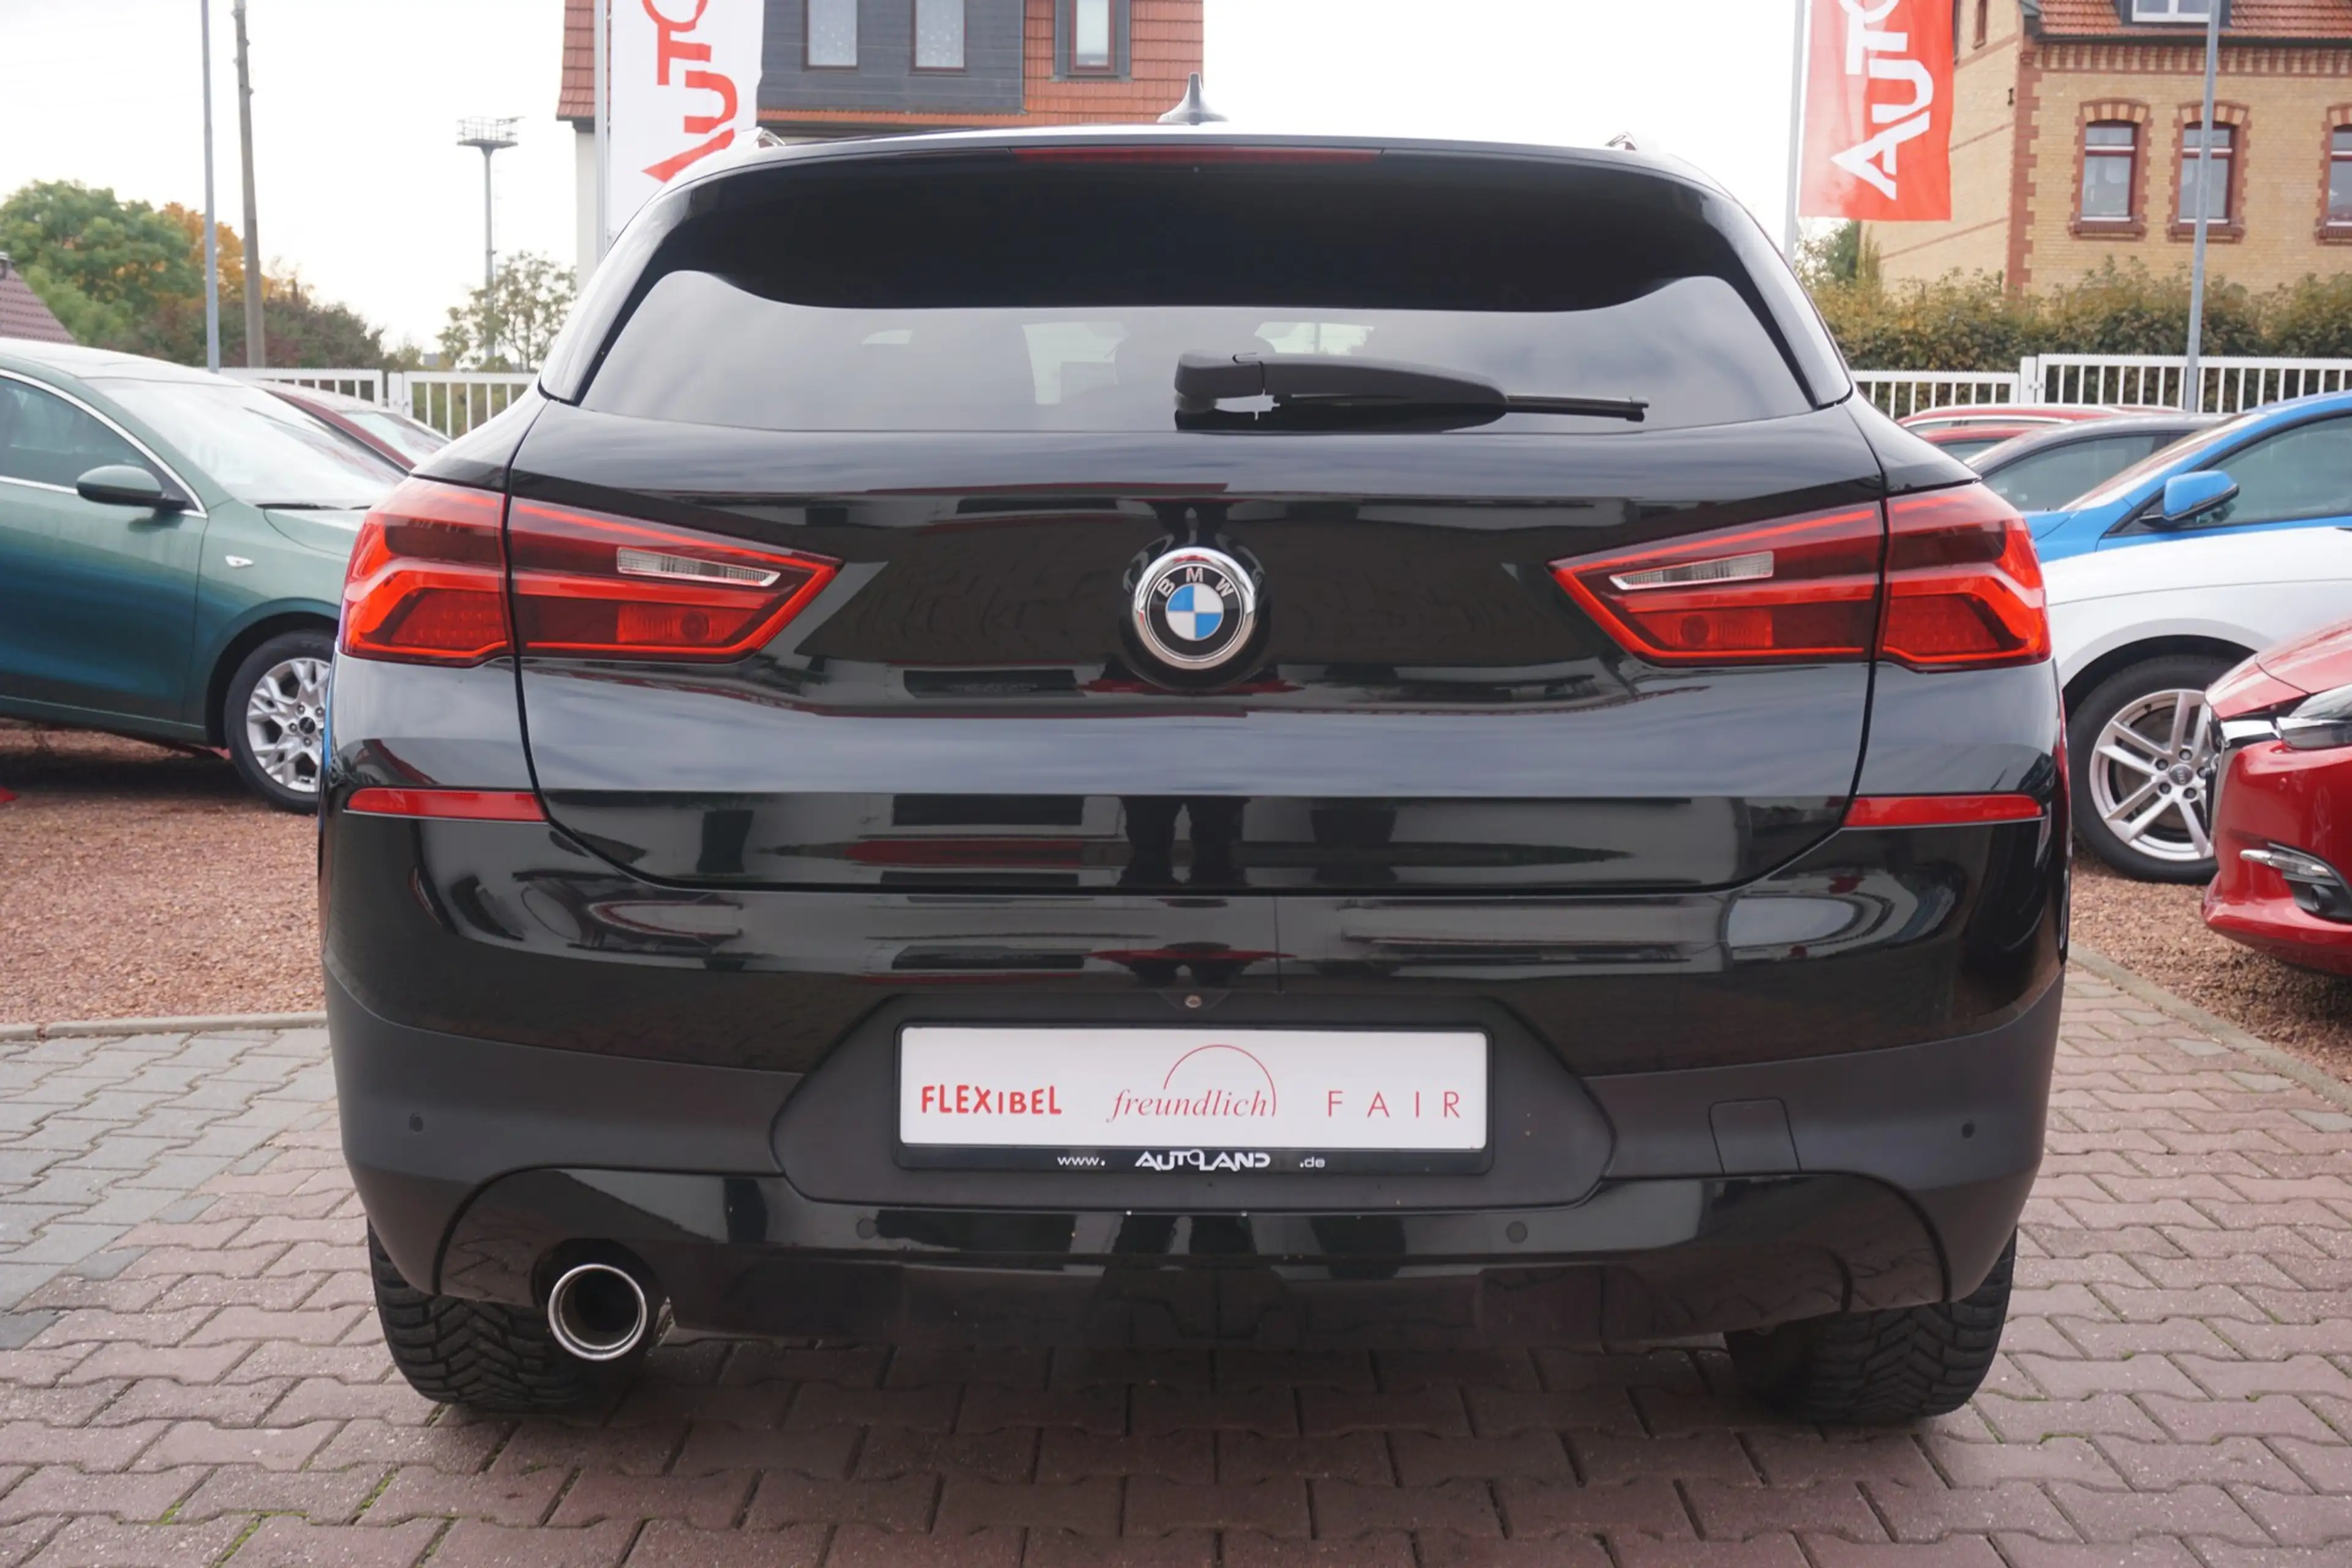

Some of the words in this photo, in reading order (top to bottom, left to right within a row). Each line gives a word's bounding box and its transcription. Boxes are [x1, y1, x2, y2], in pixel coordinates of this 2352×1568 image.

[1158, 567, 1234, 598] BMW
[921, 1084, 1062, 1115] FLEXIBEL
[1106, 1088, 1267, 1123] freundlich
[1328, 1090, 1460, 1118] FAIR
[1057, 1155, 1106, 1166] www.
[1135, 1149, 1271, 1172] AUTOLAND
[1300, 1156, 1325, 1168] .de
